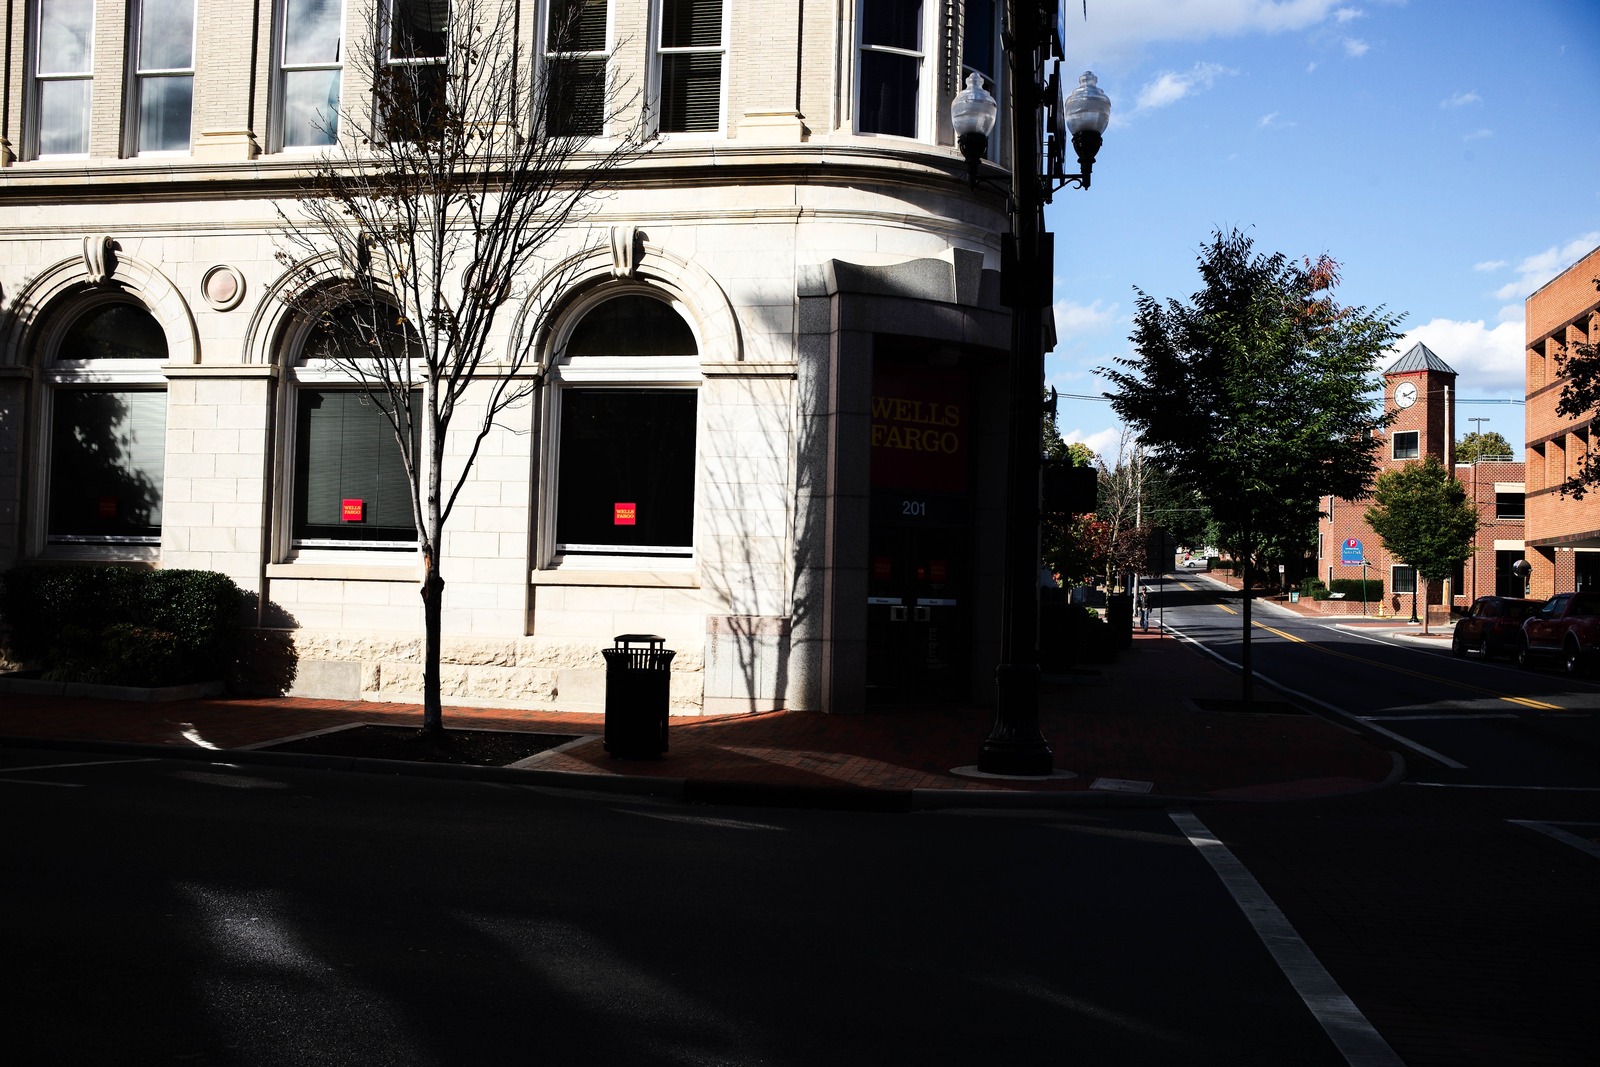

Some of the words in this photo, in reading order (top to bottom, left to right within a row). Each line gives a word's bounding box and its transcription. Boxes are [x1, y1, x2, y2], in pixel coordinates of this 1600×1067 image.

[871, 396, 960, 427] WELLS
[871, 424, 959, 454] FARGO
[902, 500, 926, 516] 201
